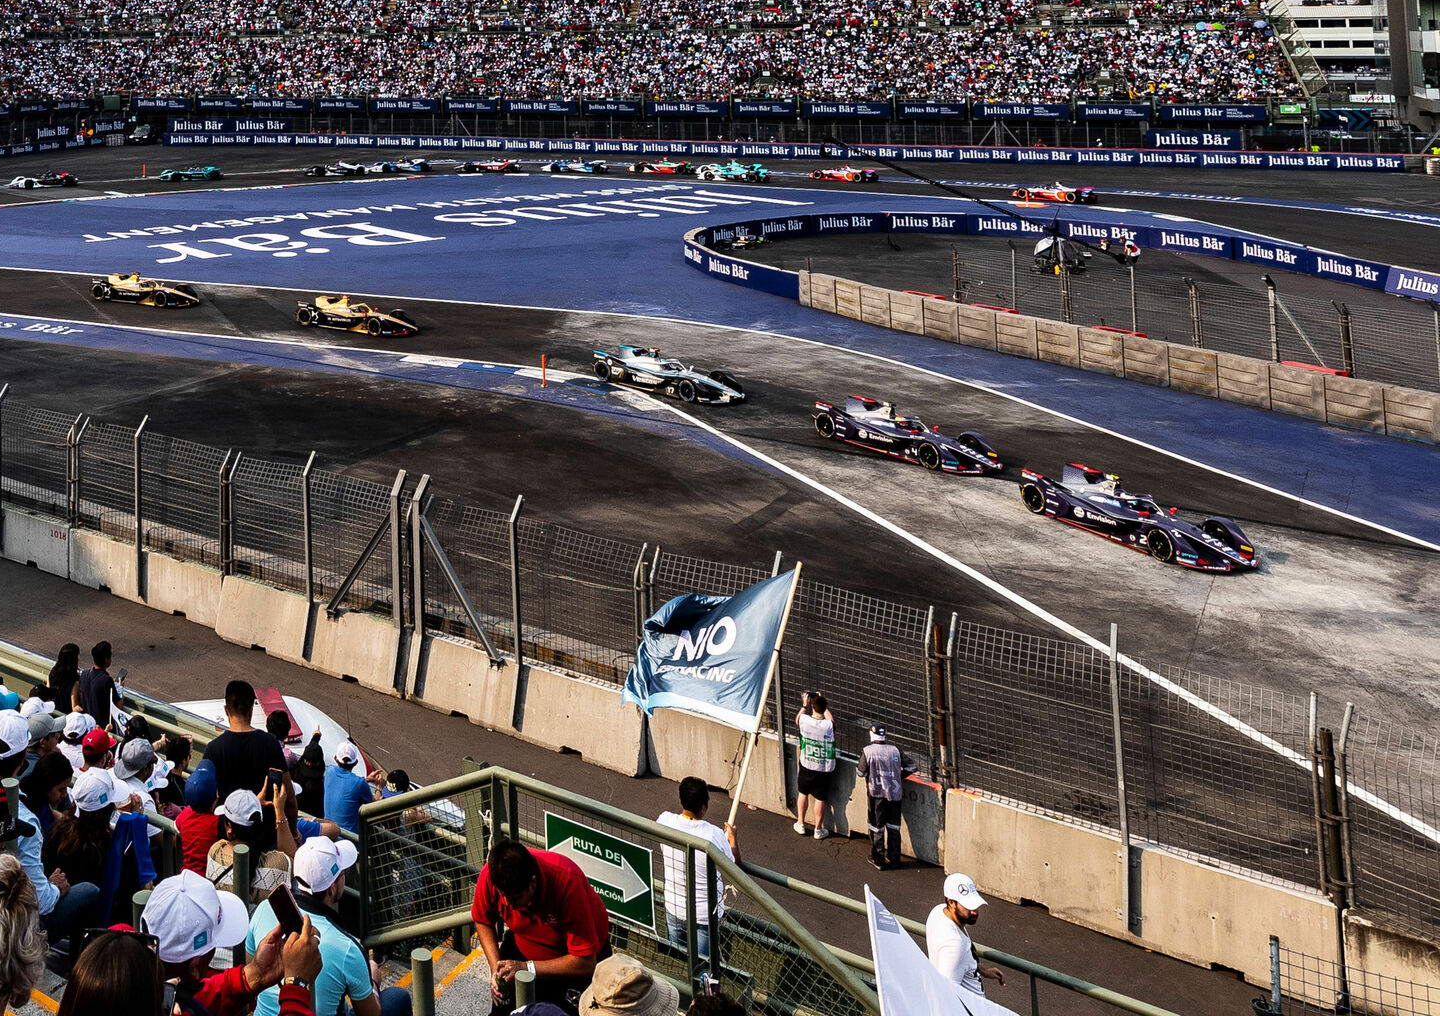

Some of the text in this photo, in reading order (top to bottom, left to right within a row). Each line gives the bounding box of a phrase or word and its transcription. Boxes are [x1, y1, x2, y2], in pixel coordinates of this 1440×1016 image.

[812, 105, 837, 113] Julius
[984, 106, 1030, 115] Julius Bär
[1172, 108, 1223, 116] Julius Bär
[96, 121, 124, 133] Julius Bär
[174, 120, 285, 132] Julius Bär Julius Bär
[38, 126, 70, 139] Julius Bär
[170, 136, 192, 144] Julius
[1156, 133, 1230, 148] Julius Bär
[595, 143, 638, 152] Julius Bär
[643, 144, 687, 152] Julius Bär
[692, 144, 737, 154] Julius Bär
[743, 146, 789, 154] Julius Bär
[903, 149, 954, 158] Julius Bär
[960, 150, 1012, 160] Julius Bär
[1018, 151, 1072, 161] Julius Bär
[1078, 152, 1133, 162] Julius Bär
[1140, 153, 1196, 164] Julius Bär
[1203, 154, 1262, 164] Julius Bär
[1269, 156, 1330, 166] Julius Bär
[1336, 157, 1400, 168] Julius Bär
[82, 204, 417, 244] MANAGEMENT
[762, 220, 803, 234] Julius Bär
[820, 216, 872, 230] Julius Bär
[892, 216, 955, 228] Julius Bär
[978, 218, 1016, 231] Julius
[714, 230, 734, 243] Julius
[1070, 224, 1136, 240] Julius Bär
[1162, 232, 1224, 252] Julius Bär
[1242, 242, 1296, 264] Julius Bär
[732, 264, 749, 280] Bär
[1318, 257, 1378, 281] Julius Bär
[1397, 274, 1438, 294] Julius
[21, 324, 84, 334] Bär
[868, 432, 894, 443] Envision
[911, 447, 918, 456] 4
[1086, 512, 1116, 526] Envision
[50, 530, 67, 540] 1018
[1139, 534, 1148, 544] 2
[672, 616, 736, 662] NIO
[573, 837, 621, 863] RUTA DE
